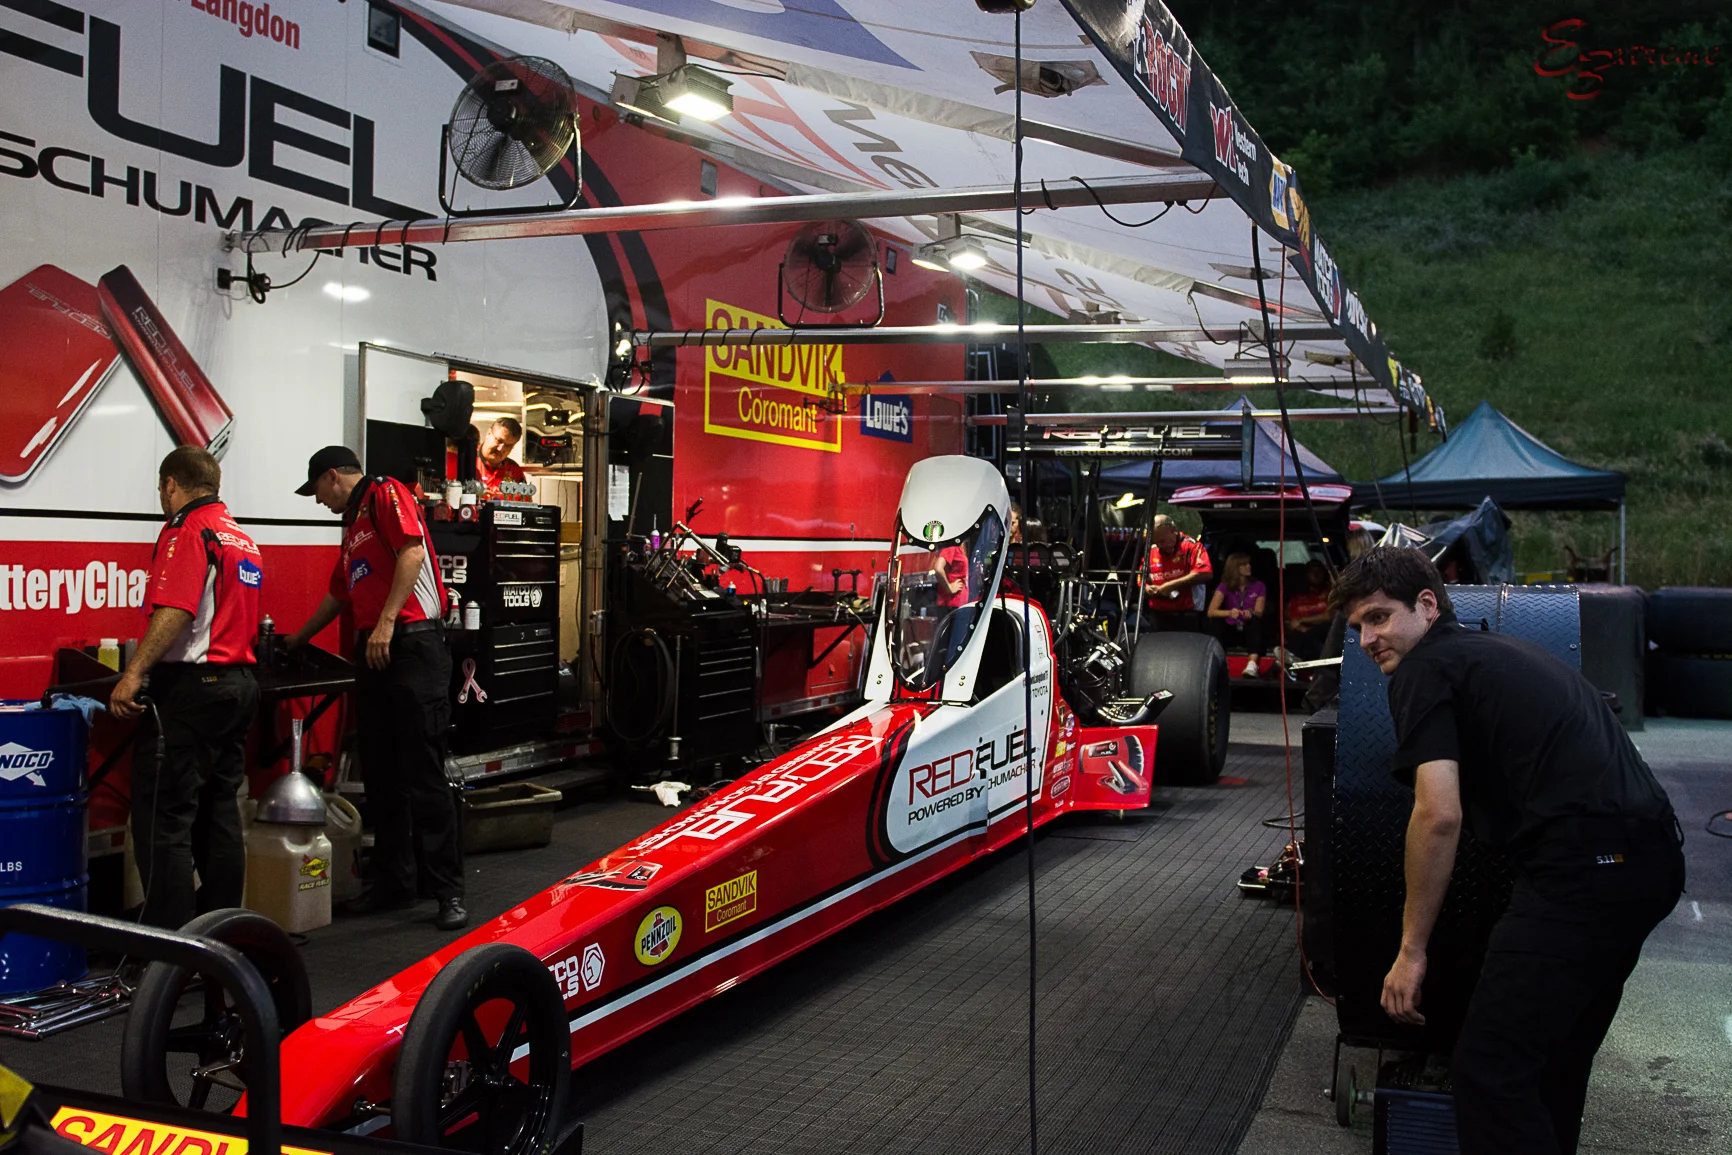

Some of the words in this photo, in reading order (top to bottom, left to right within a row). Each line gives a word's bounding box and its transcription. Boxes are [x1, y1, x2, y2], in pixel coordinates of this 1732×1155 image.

[0, 131, 438, 281] SCHUMAER
[738, 386, 818, 433] Coromant
[436, 555, 467, 569] CO
[503, 596, 531, 608] TOOLS
[908, 794, 965, 826] POWERED
[965, 785, 985, 802] BY
[707, 872, 756, 910] SANDVIK
[716, 900, 747, 922] Coromant
[641, 915, 677, 956] PENNZOIL
